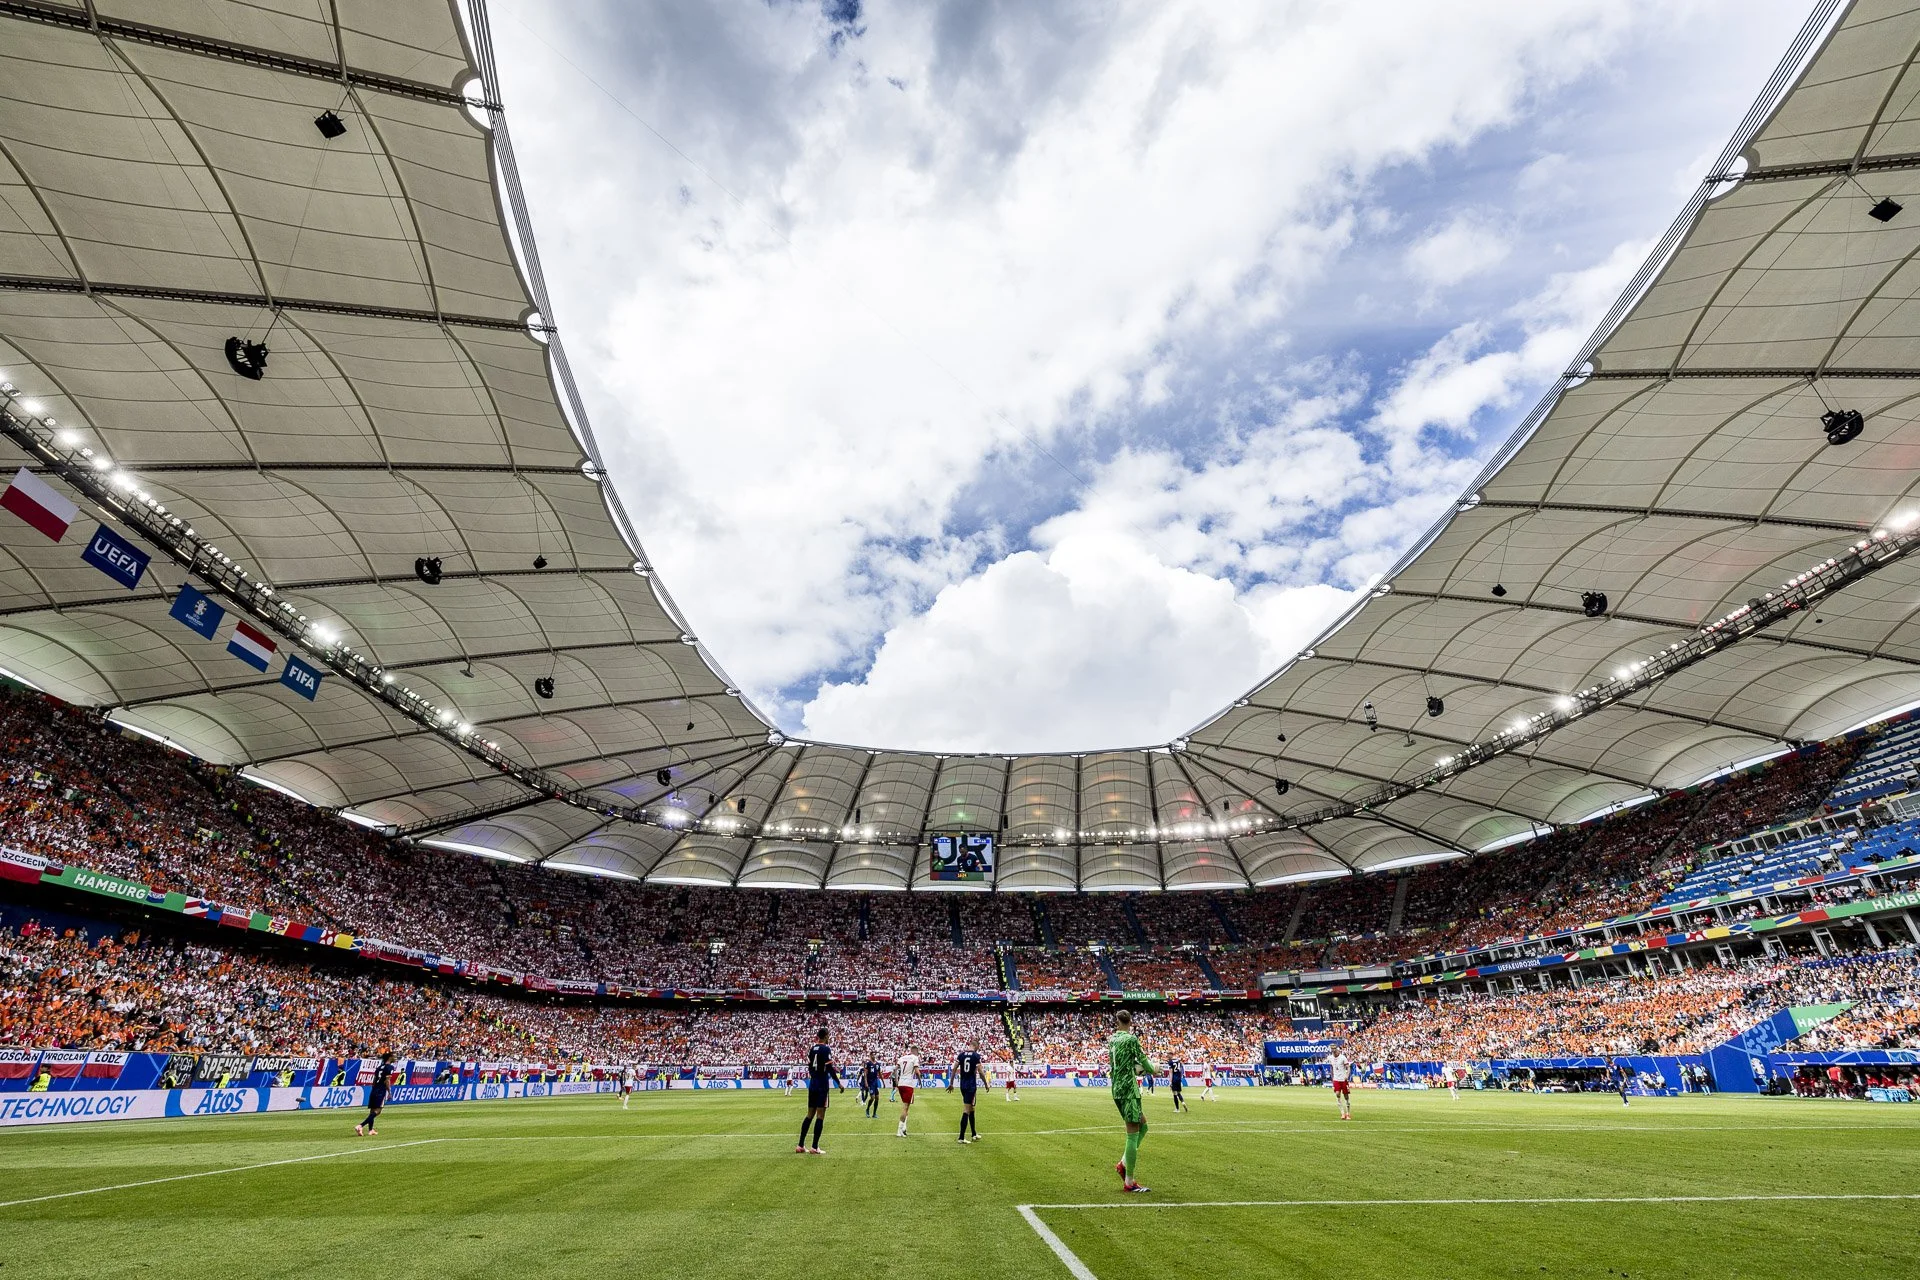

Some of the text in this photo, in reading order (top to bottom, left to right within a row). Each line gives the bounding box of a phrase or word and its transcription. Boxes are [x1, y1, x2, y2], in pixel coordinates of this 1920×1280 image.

[94, 537, 138, 577] UEFA
[288, 665, 315, 690] FIFA
[2, 851, 46, 867] SZCZECIN
[74, 873, 146, 899] HAMBURG
[44, 1052, 87, 1060] WROCŁAW
[812, 1053, 818, 1071] 4
[963, 1057, 971, 1073] 6
[200, 1056, 247, 1079] SPENGE
[902, 1061, 908, 1075] 7
[0, 1095, 137, 1119] TECHNOLOGY
